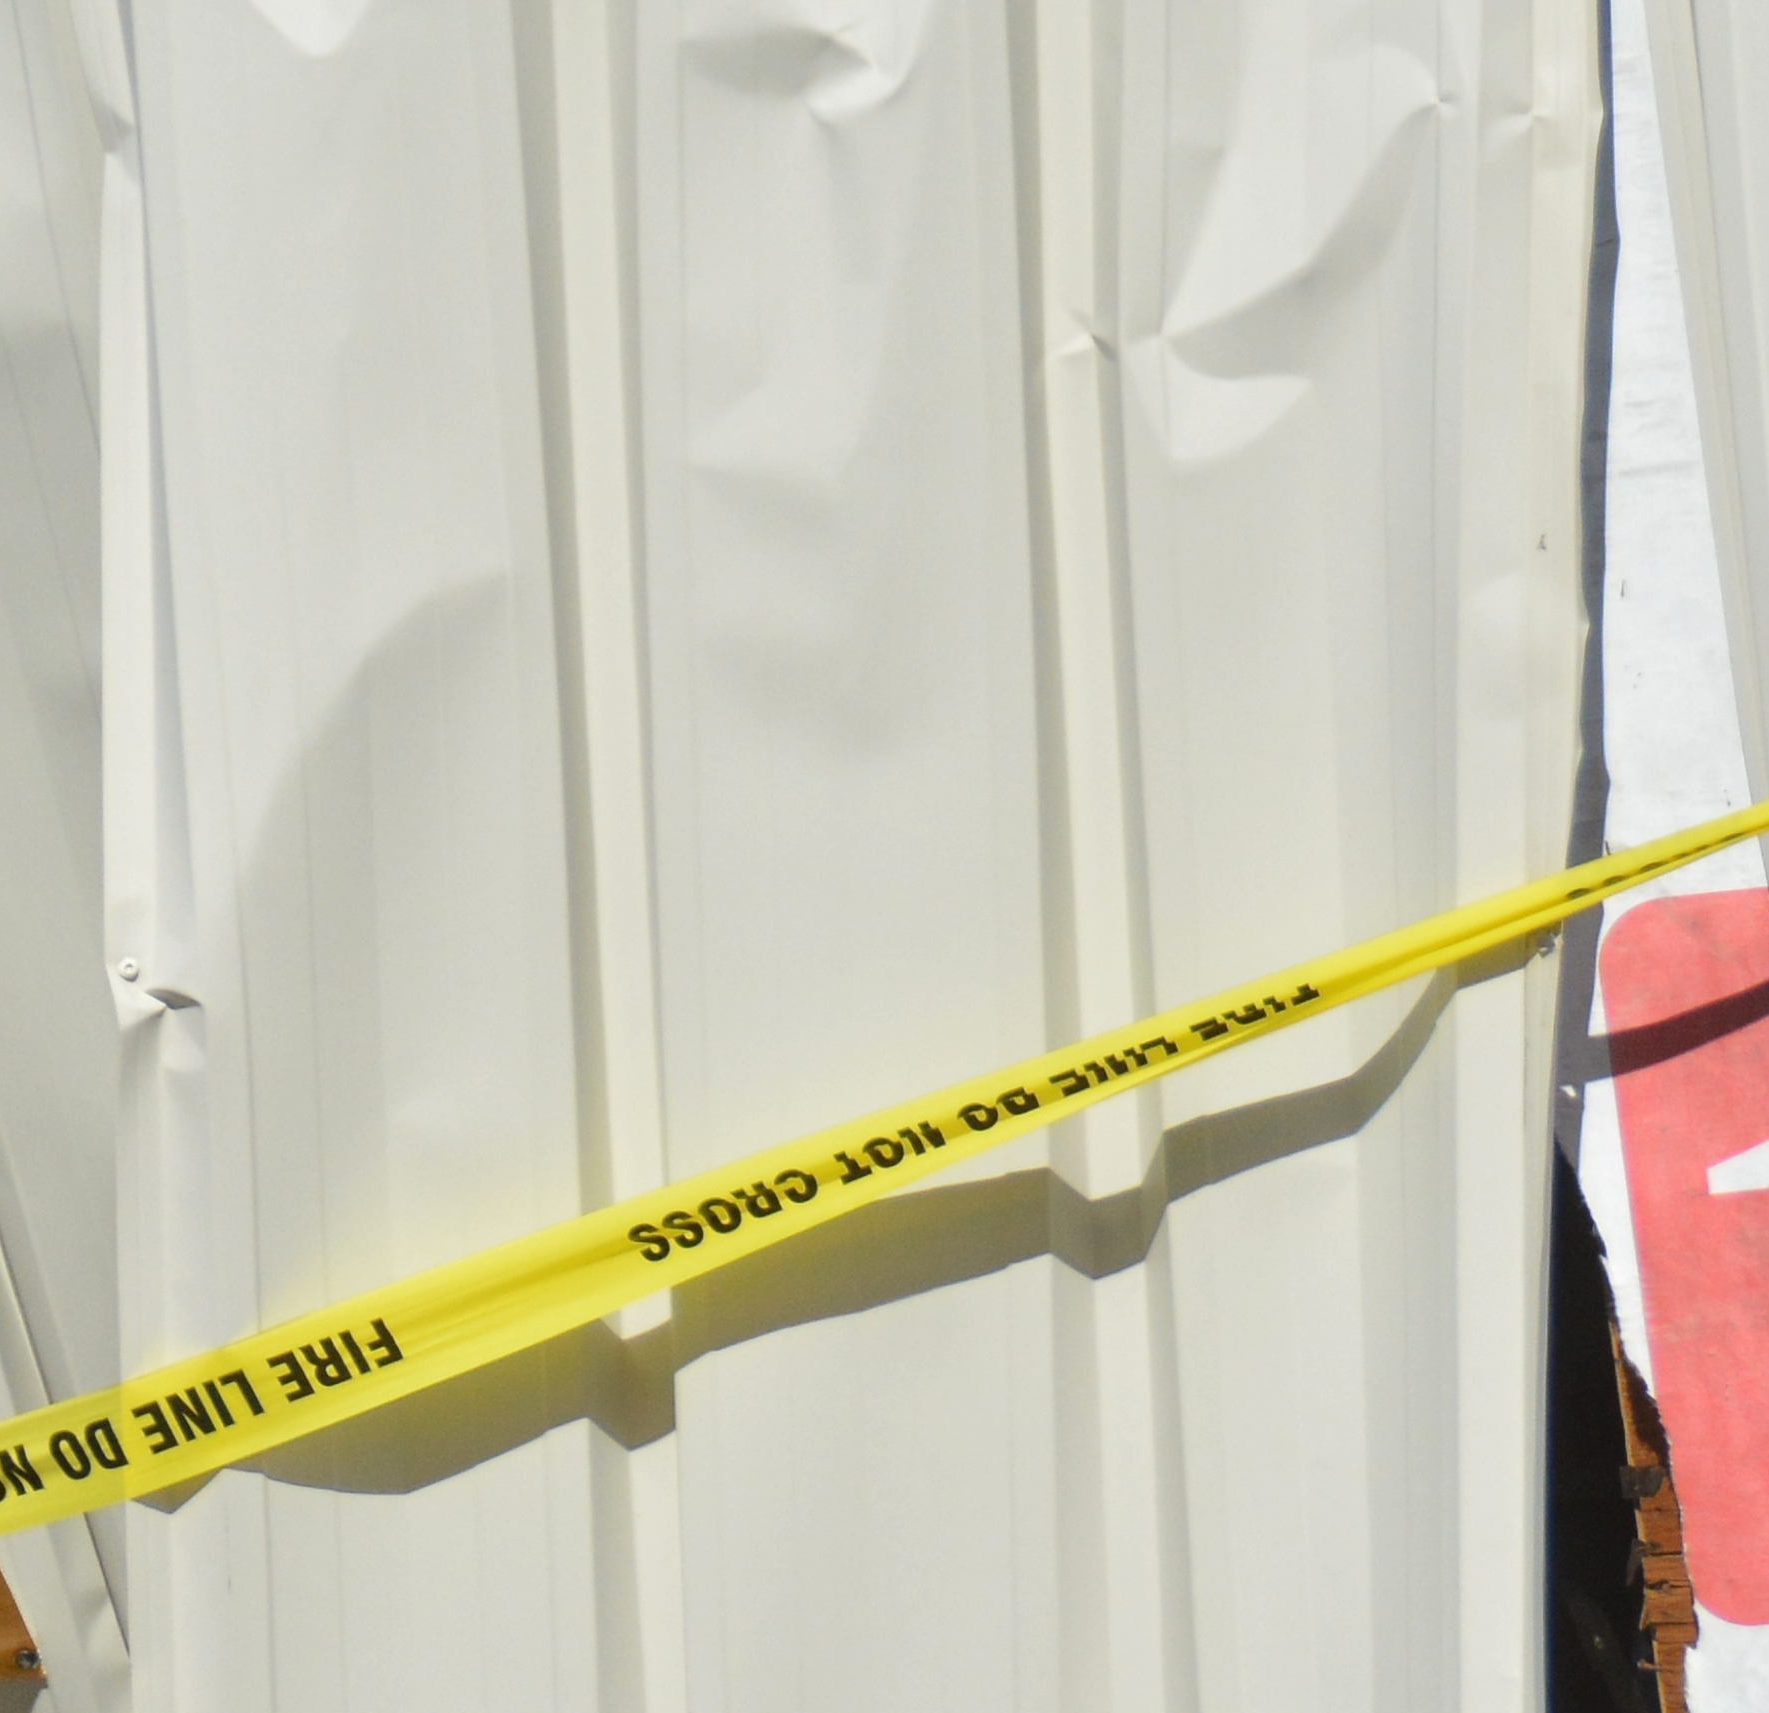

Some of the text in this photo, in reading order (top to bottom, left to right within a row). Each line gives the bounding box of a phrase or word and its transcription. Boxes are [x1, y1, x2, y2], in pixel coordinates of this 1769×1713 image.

[627, 1166, 820, 1263] CROSS
[266, 1317, 406, 1403] FIRE
[47, 1418, 129, 1481] DO
[131, 1369, 269, 1456] LINE
